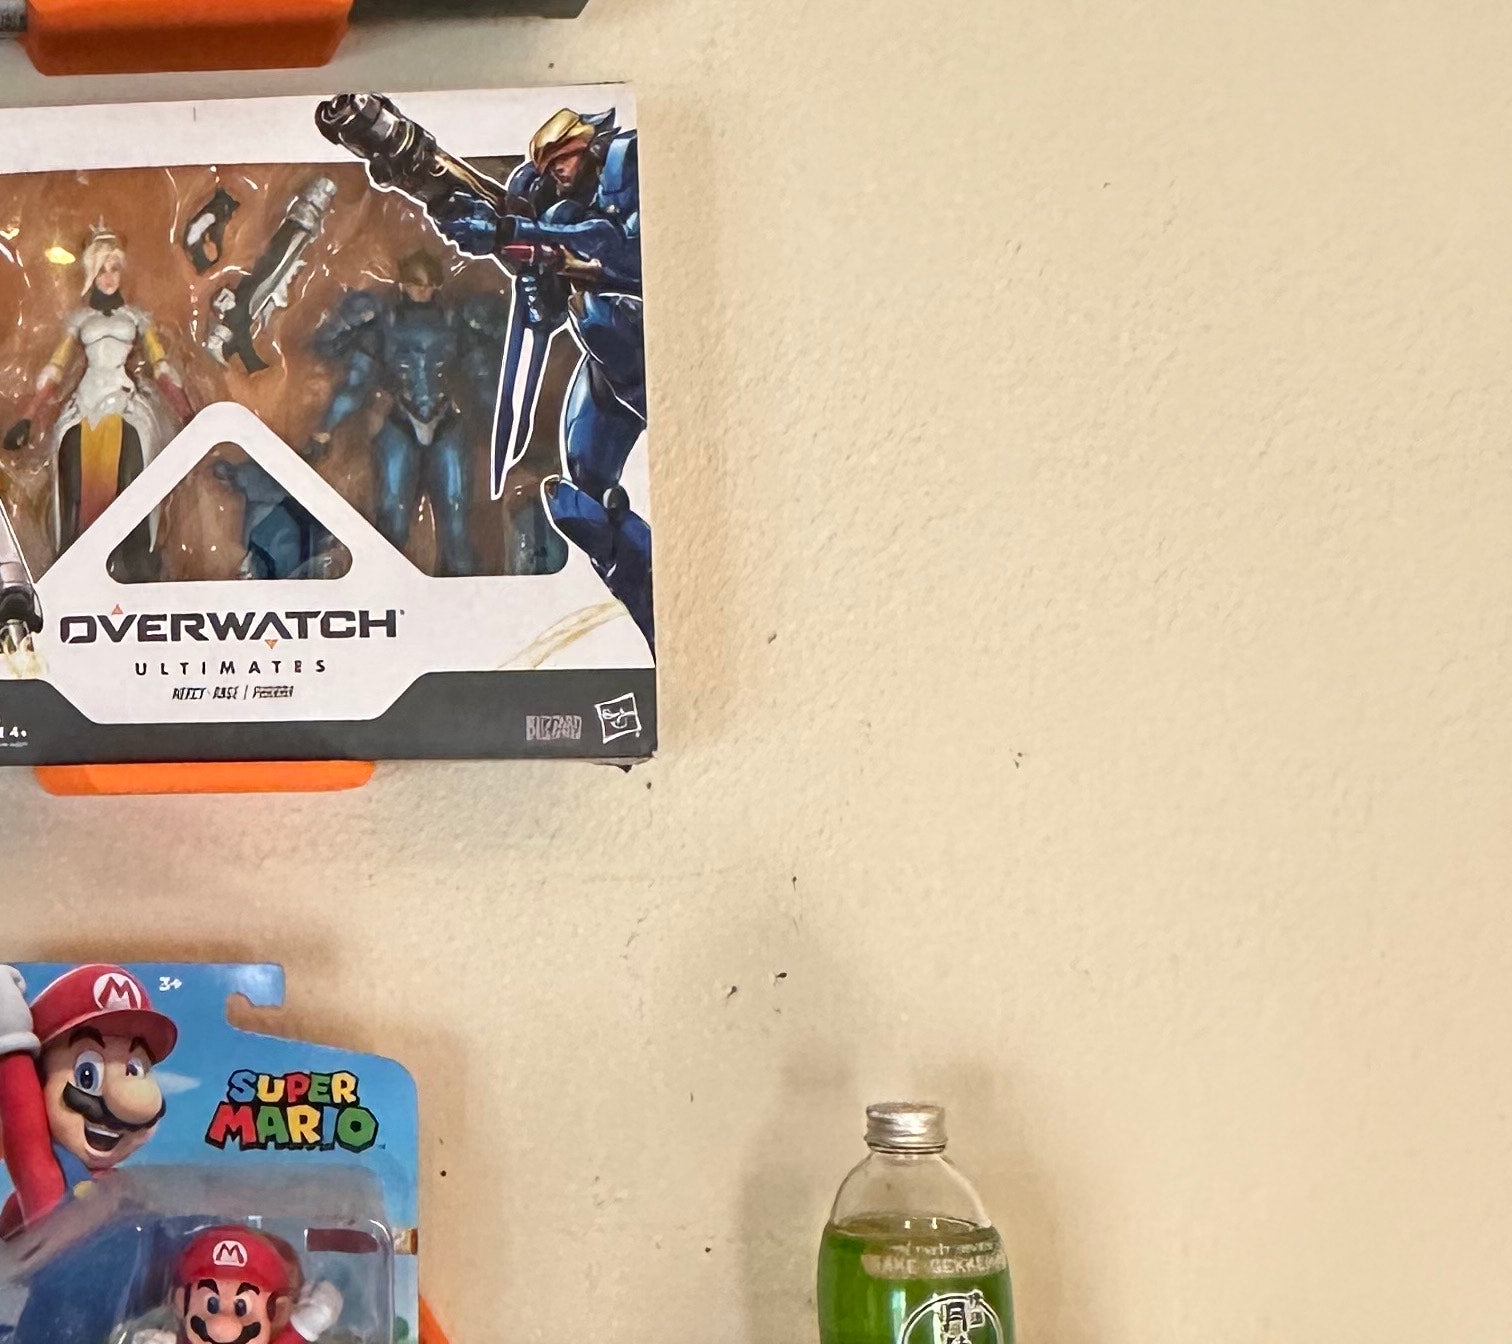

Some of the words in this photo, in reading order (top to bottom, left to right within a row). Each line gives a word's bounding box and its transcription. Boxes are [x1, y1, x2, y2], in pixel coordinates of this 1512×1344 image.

[59, 609, 398, 643] OVERWATCH
[135, 660, 327, 676] ULTIMATES
[159, 976, 182, 992] 3+
[225, 1069, 360, 1105] SUPER
[204, 1101, 379, 1153] MARIO
